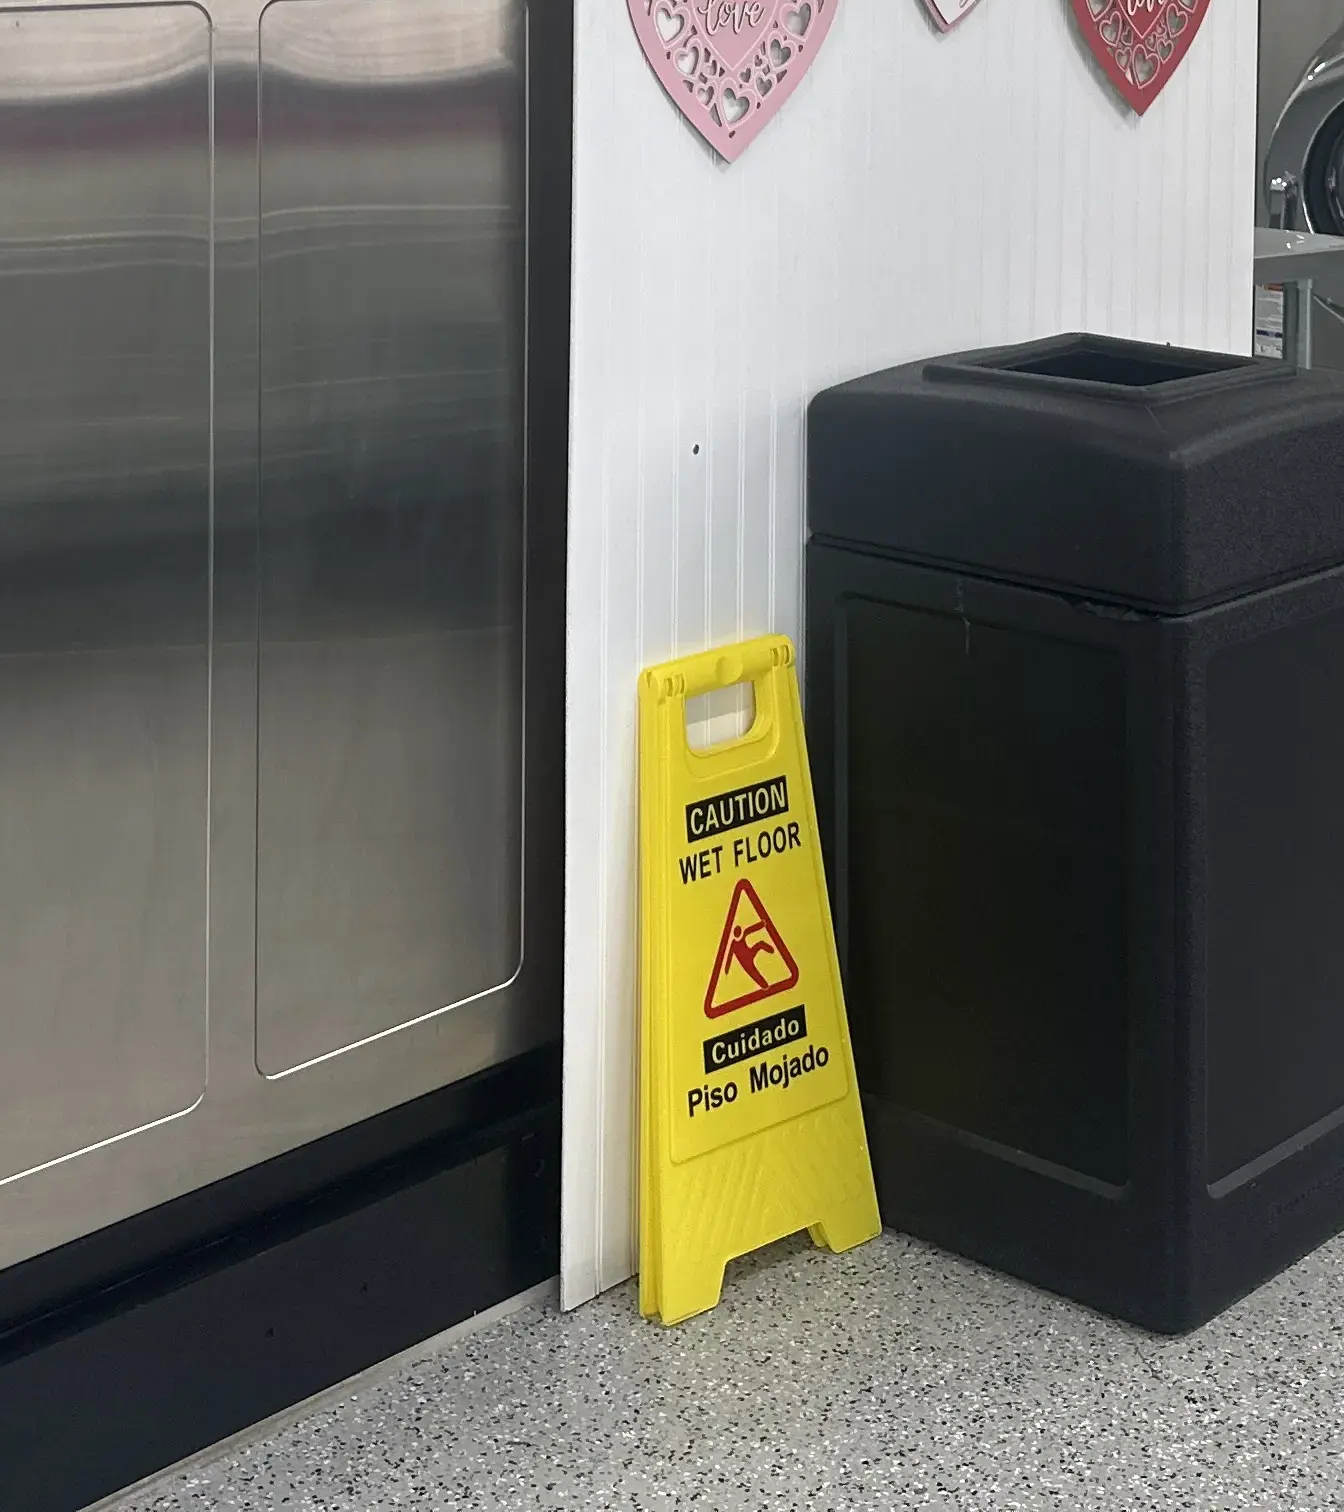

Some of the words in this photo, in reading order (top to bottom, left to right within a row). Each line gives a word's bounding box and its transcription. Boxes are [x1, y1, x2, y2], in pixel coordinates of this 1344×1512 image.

[690, 781, 786, 835] CAUTION
[679, 845, 723, 884] WET
[733, 821, 801, 867] FLOOR
[711, 1018, 800, 1064] Cuidado
[687, 1082, 738, 1117] Piso
[749, 1044, 829, 1093] Mojado
